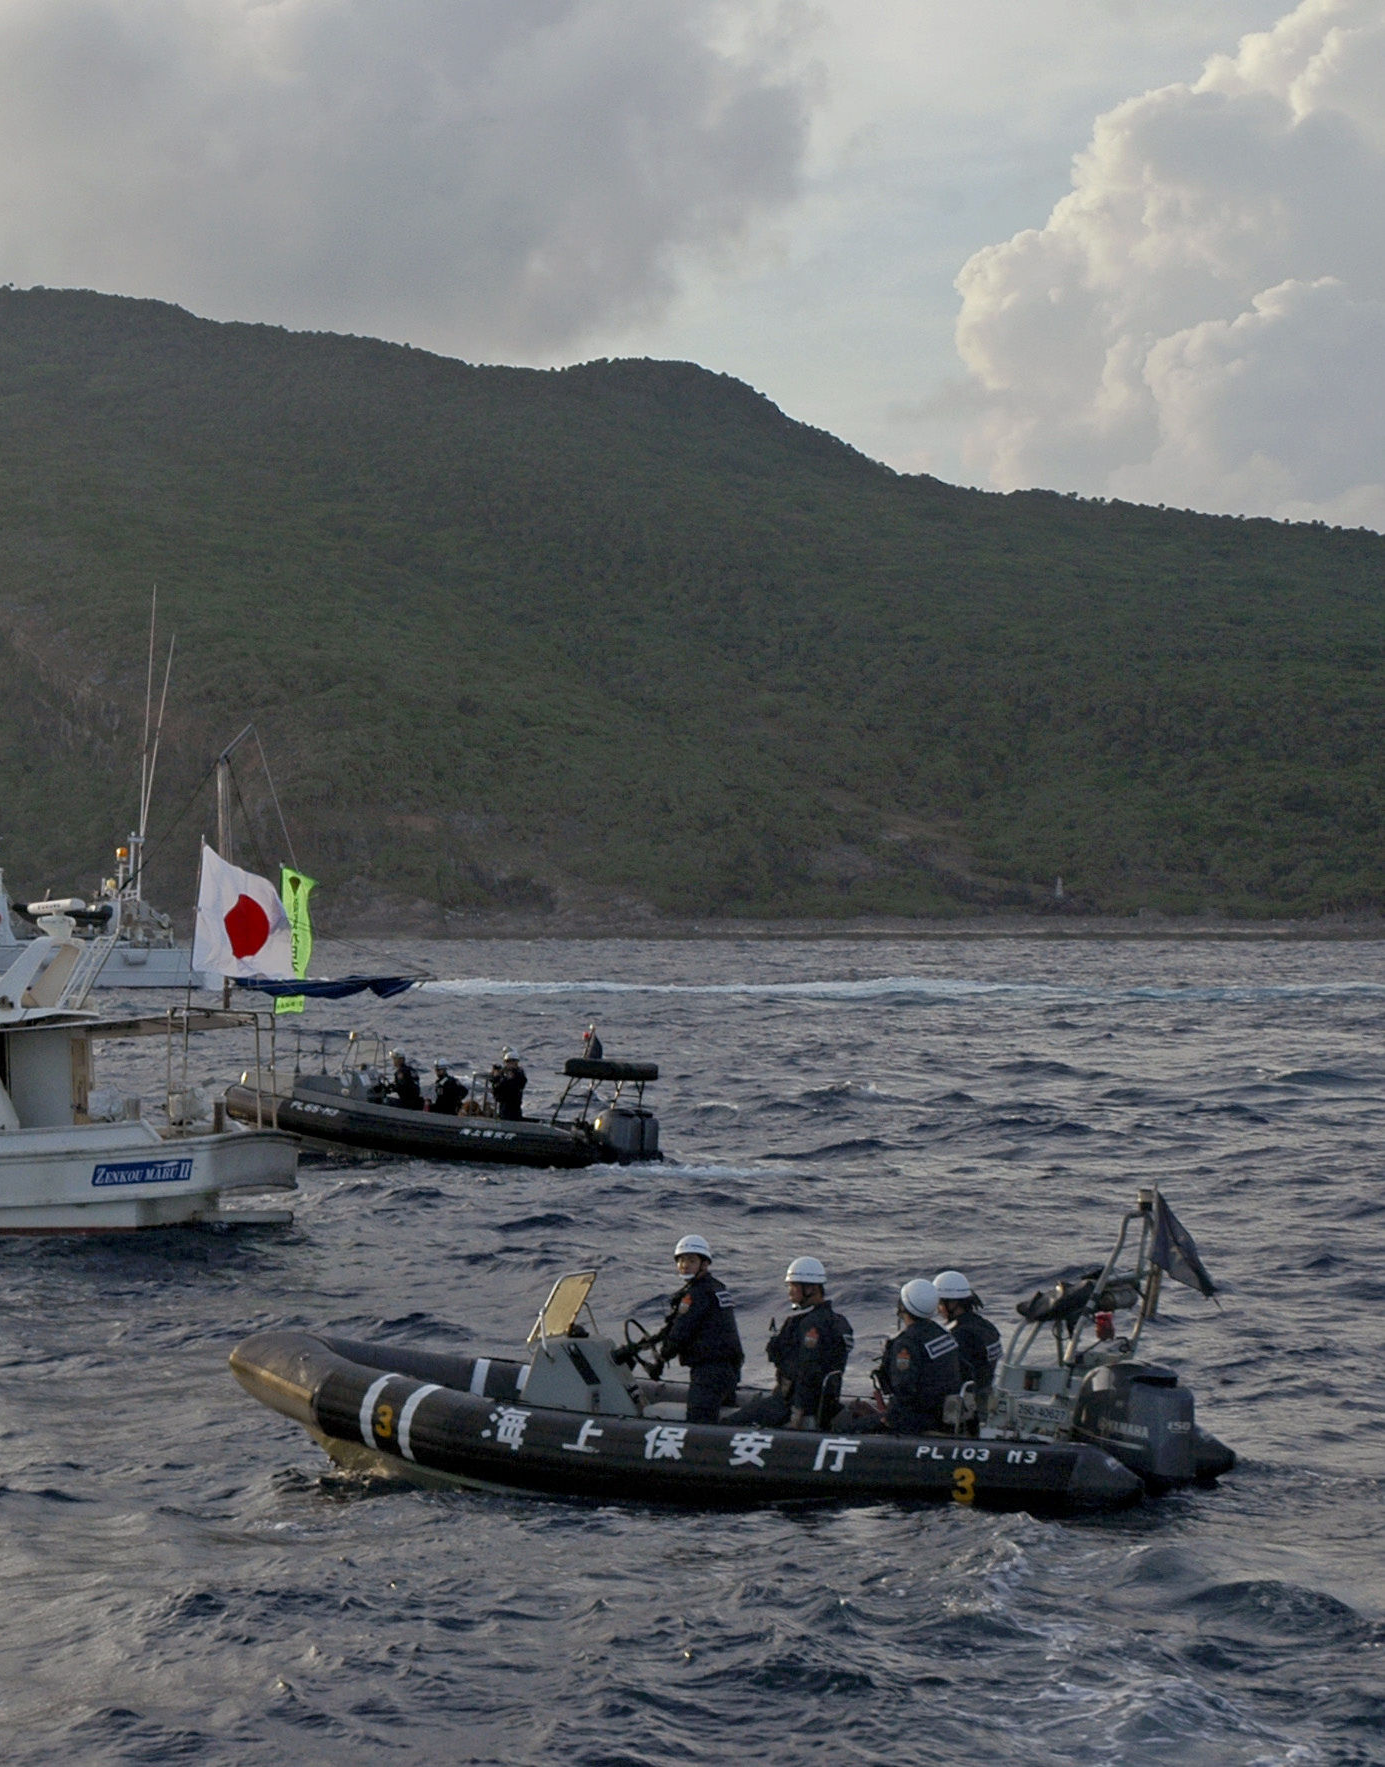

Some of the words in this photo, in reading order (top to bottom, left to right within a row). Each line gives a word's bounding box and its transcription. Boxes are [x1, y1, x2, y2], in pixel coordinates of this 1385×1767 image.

[94, 1167, 144, 1184] ZENKOU
[144, 1167, 178, 1181] MARU
[375, 1404, 393, 1438] 3
[481, 1406, 861, 1472] 海上保安庁
[1006, 1450, 1038, 1464] M3
[951, 1466, 976, 1505] 3
